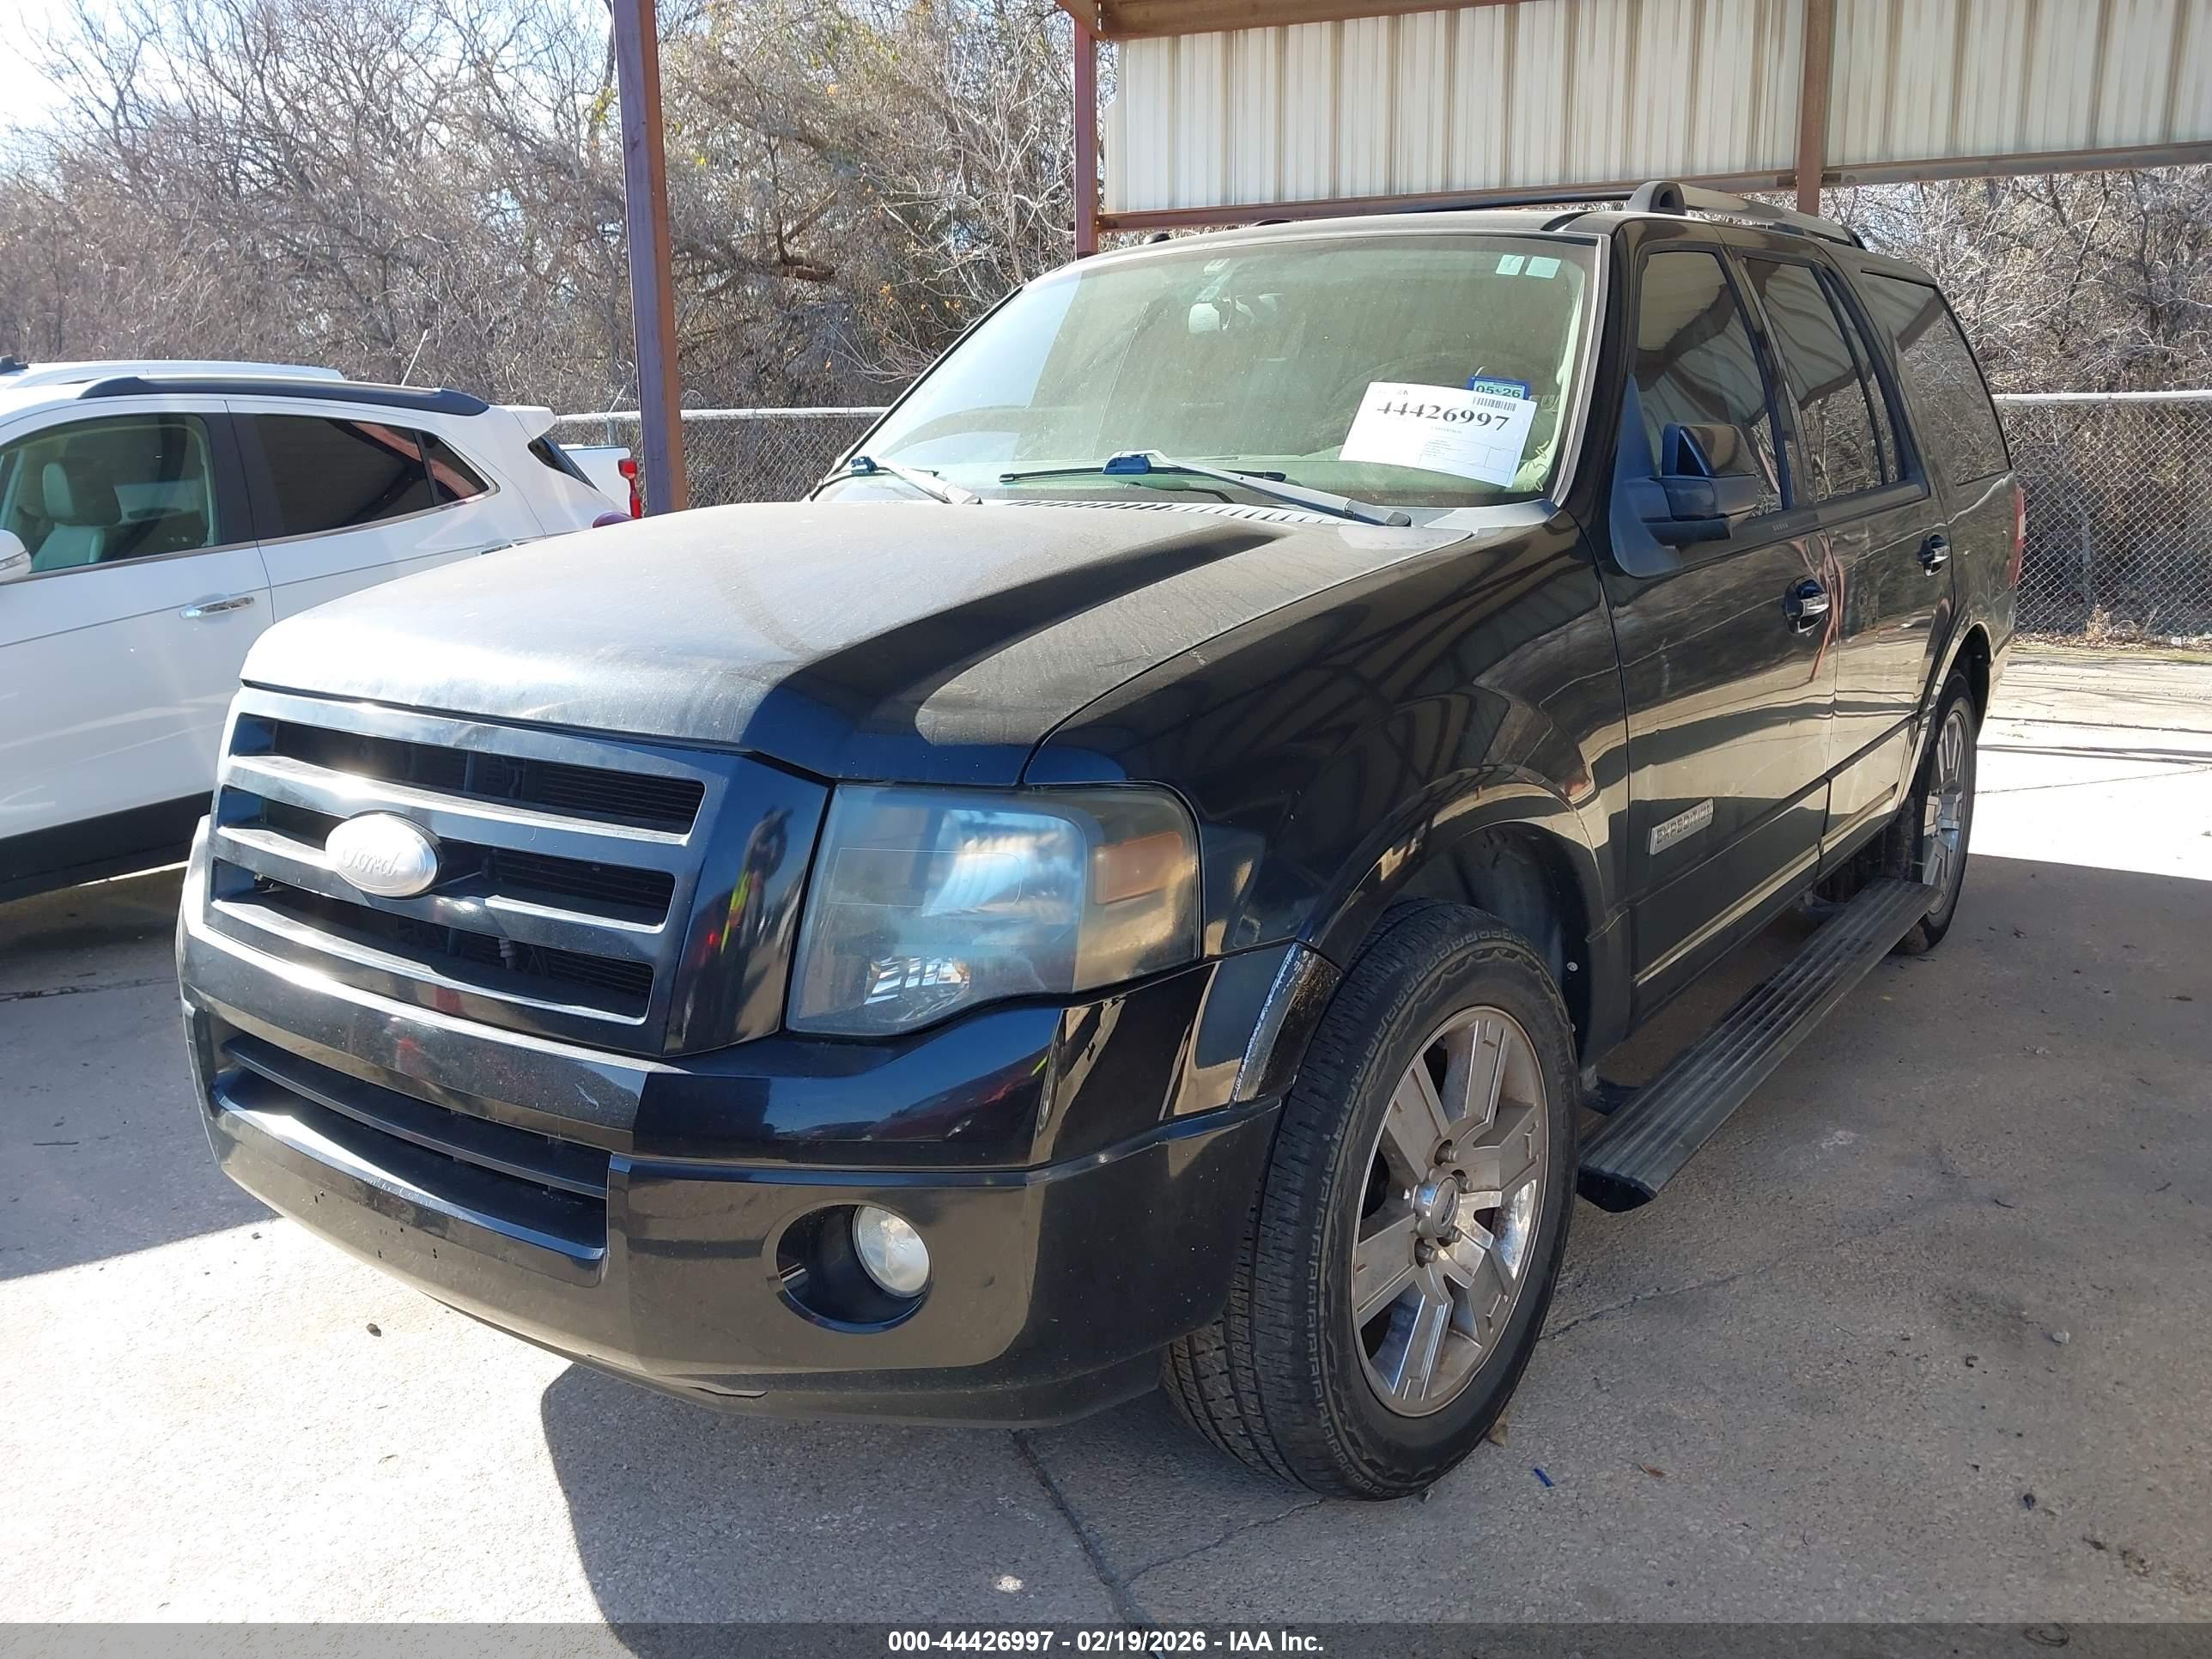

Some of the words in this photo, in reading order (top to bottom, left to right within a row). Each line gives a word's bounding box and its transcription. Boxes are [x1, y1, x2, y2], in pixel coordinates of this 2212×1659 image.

[1503, 387, 1522, 398] 26
[1376, 401, 1510, 431] 44426997
[343, 845, 400, 877] Ford
